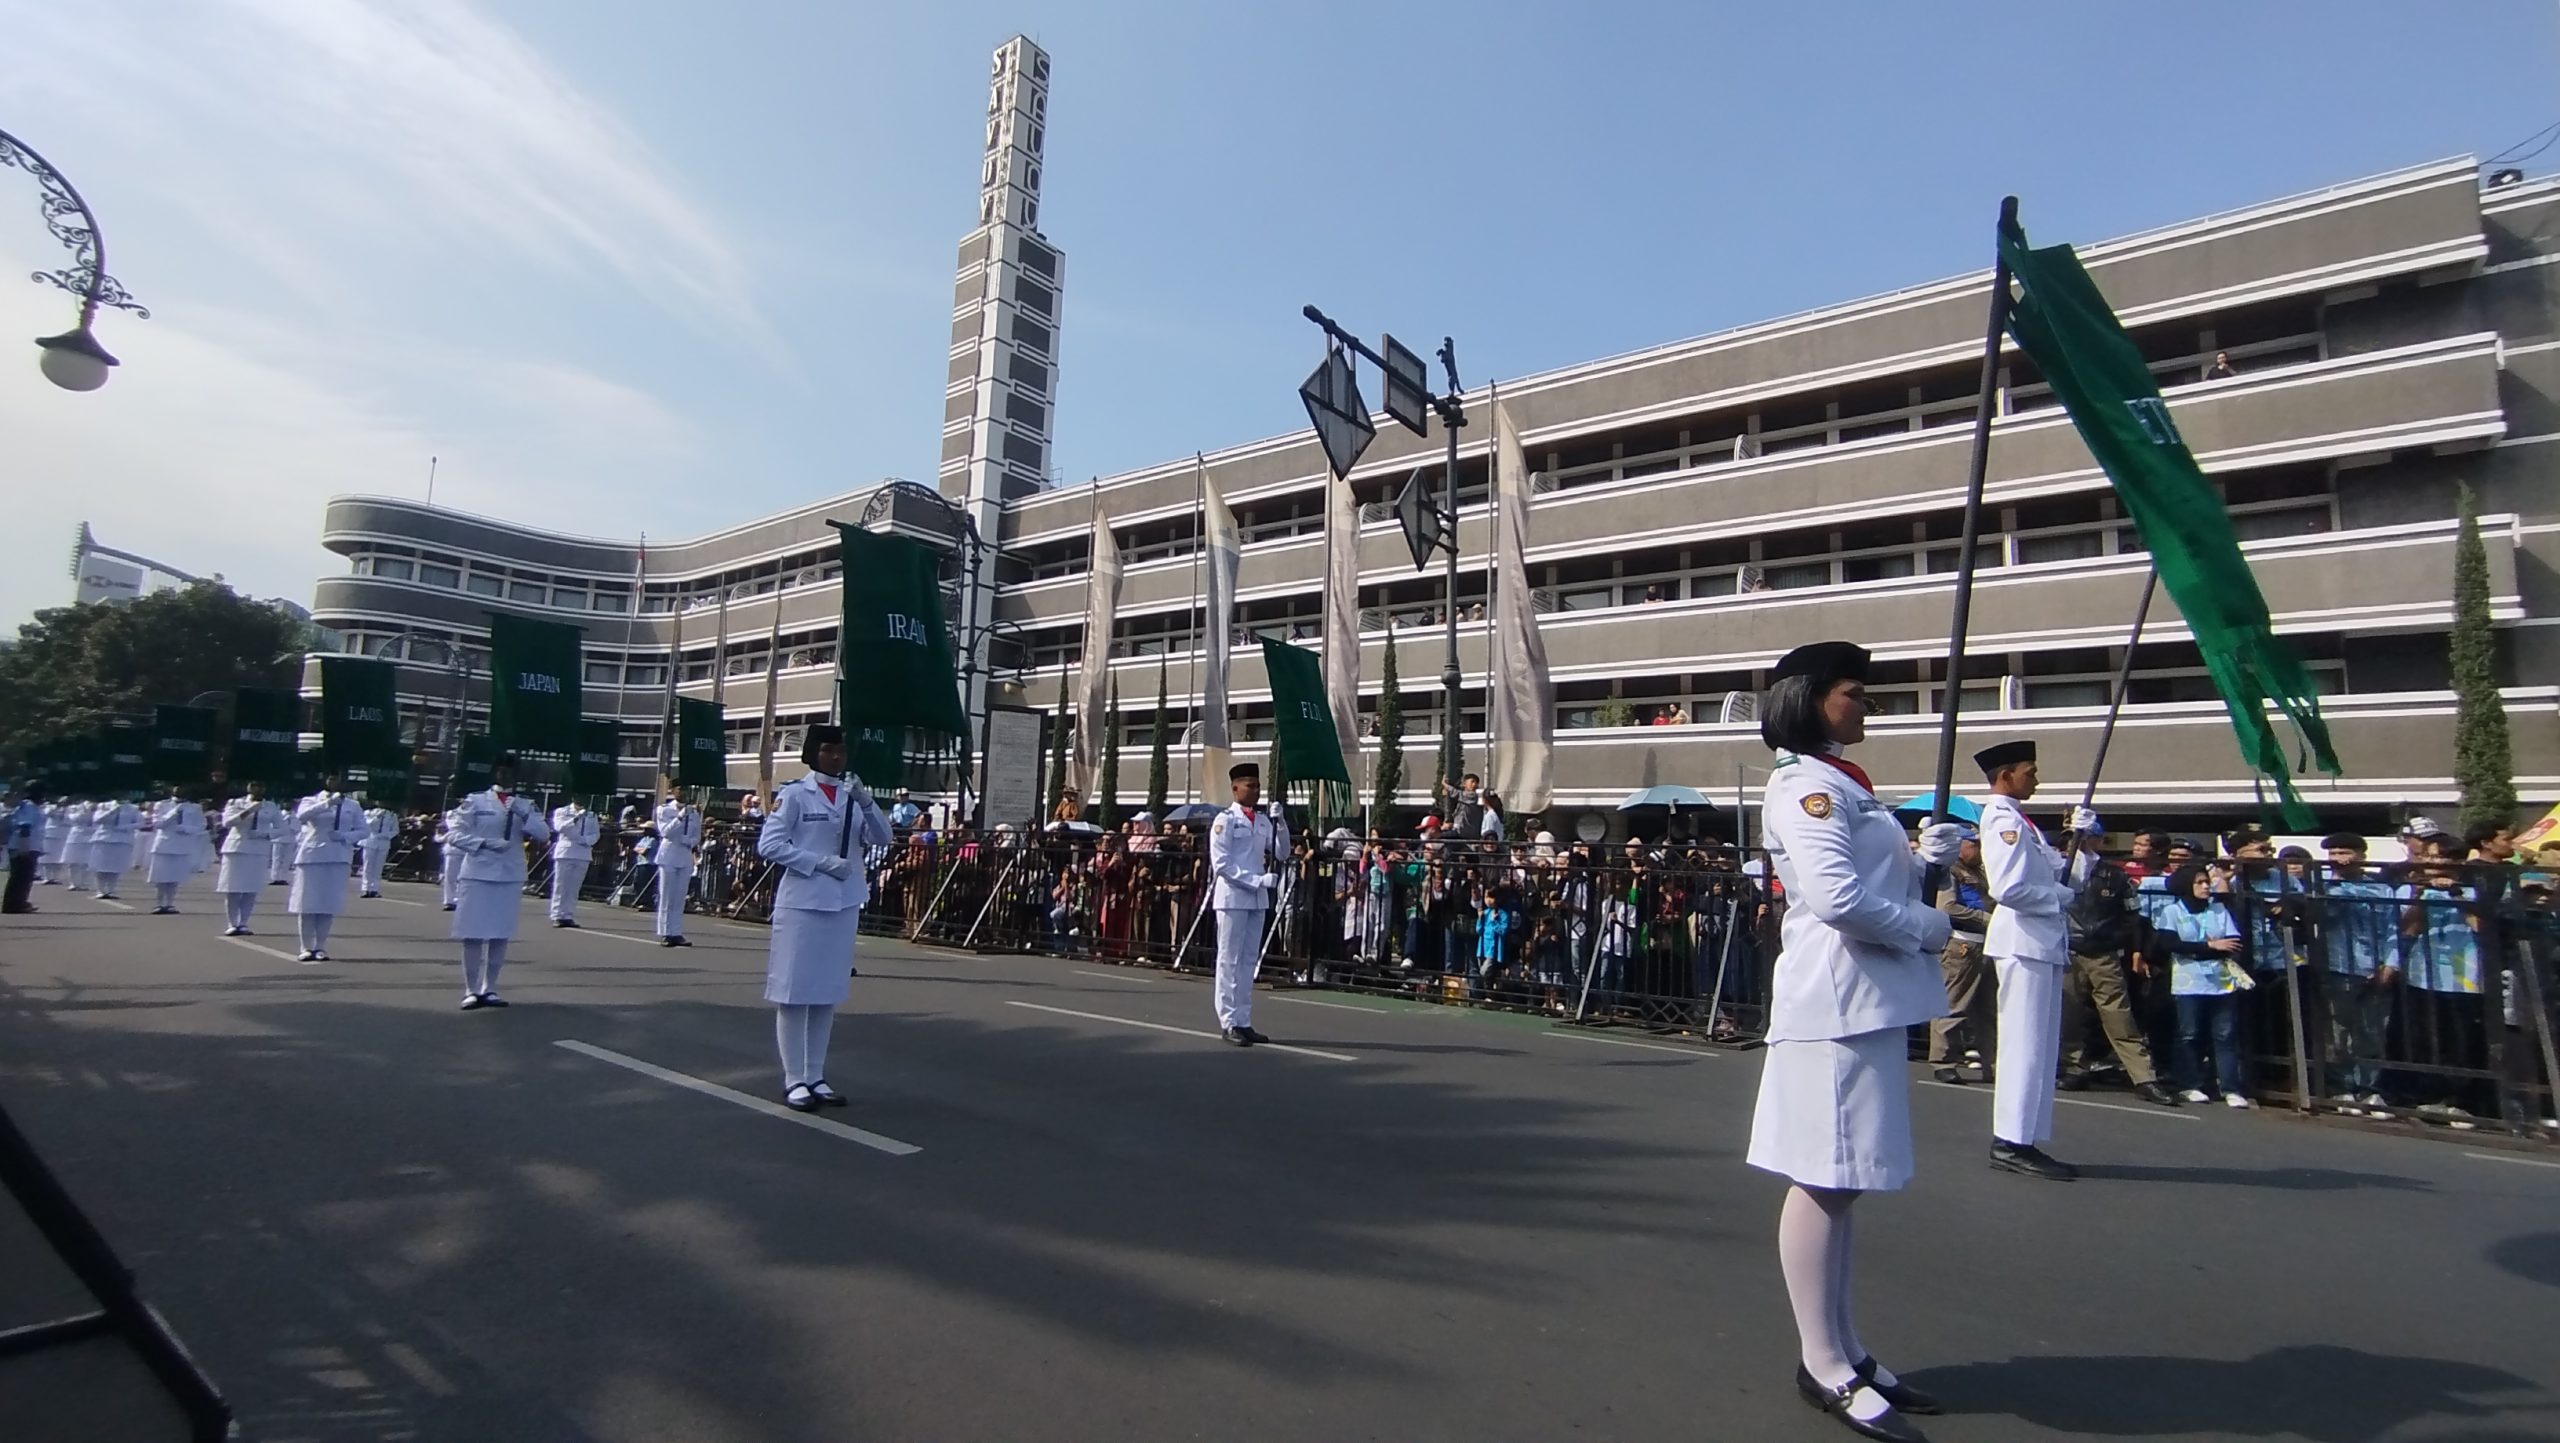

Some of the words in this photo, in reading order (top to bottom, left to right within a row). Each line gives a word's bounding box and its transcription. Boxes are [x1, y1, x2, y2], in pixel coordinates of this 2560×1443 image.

[980, 49, 1004, 222] SAVOY
[887, 613, 928, 646] IRAN
[518, 672, 561, 693] JAPAN
[348, 706, 384, 722] LAOS
